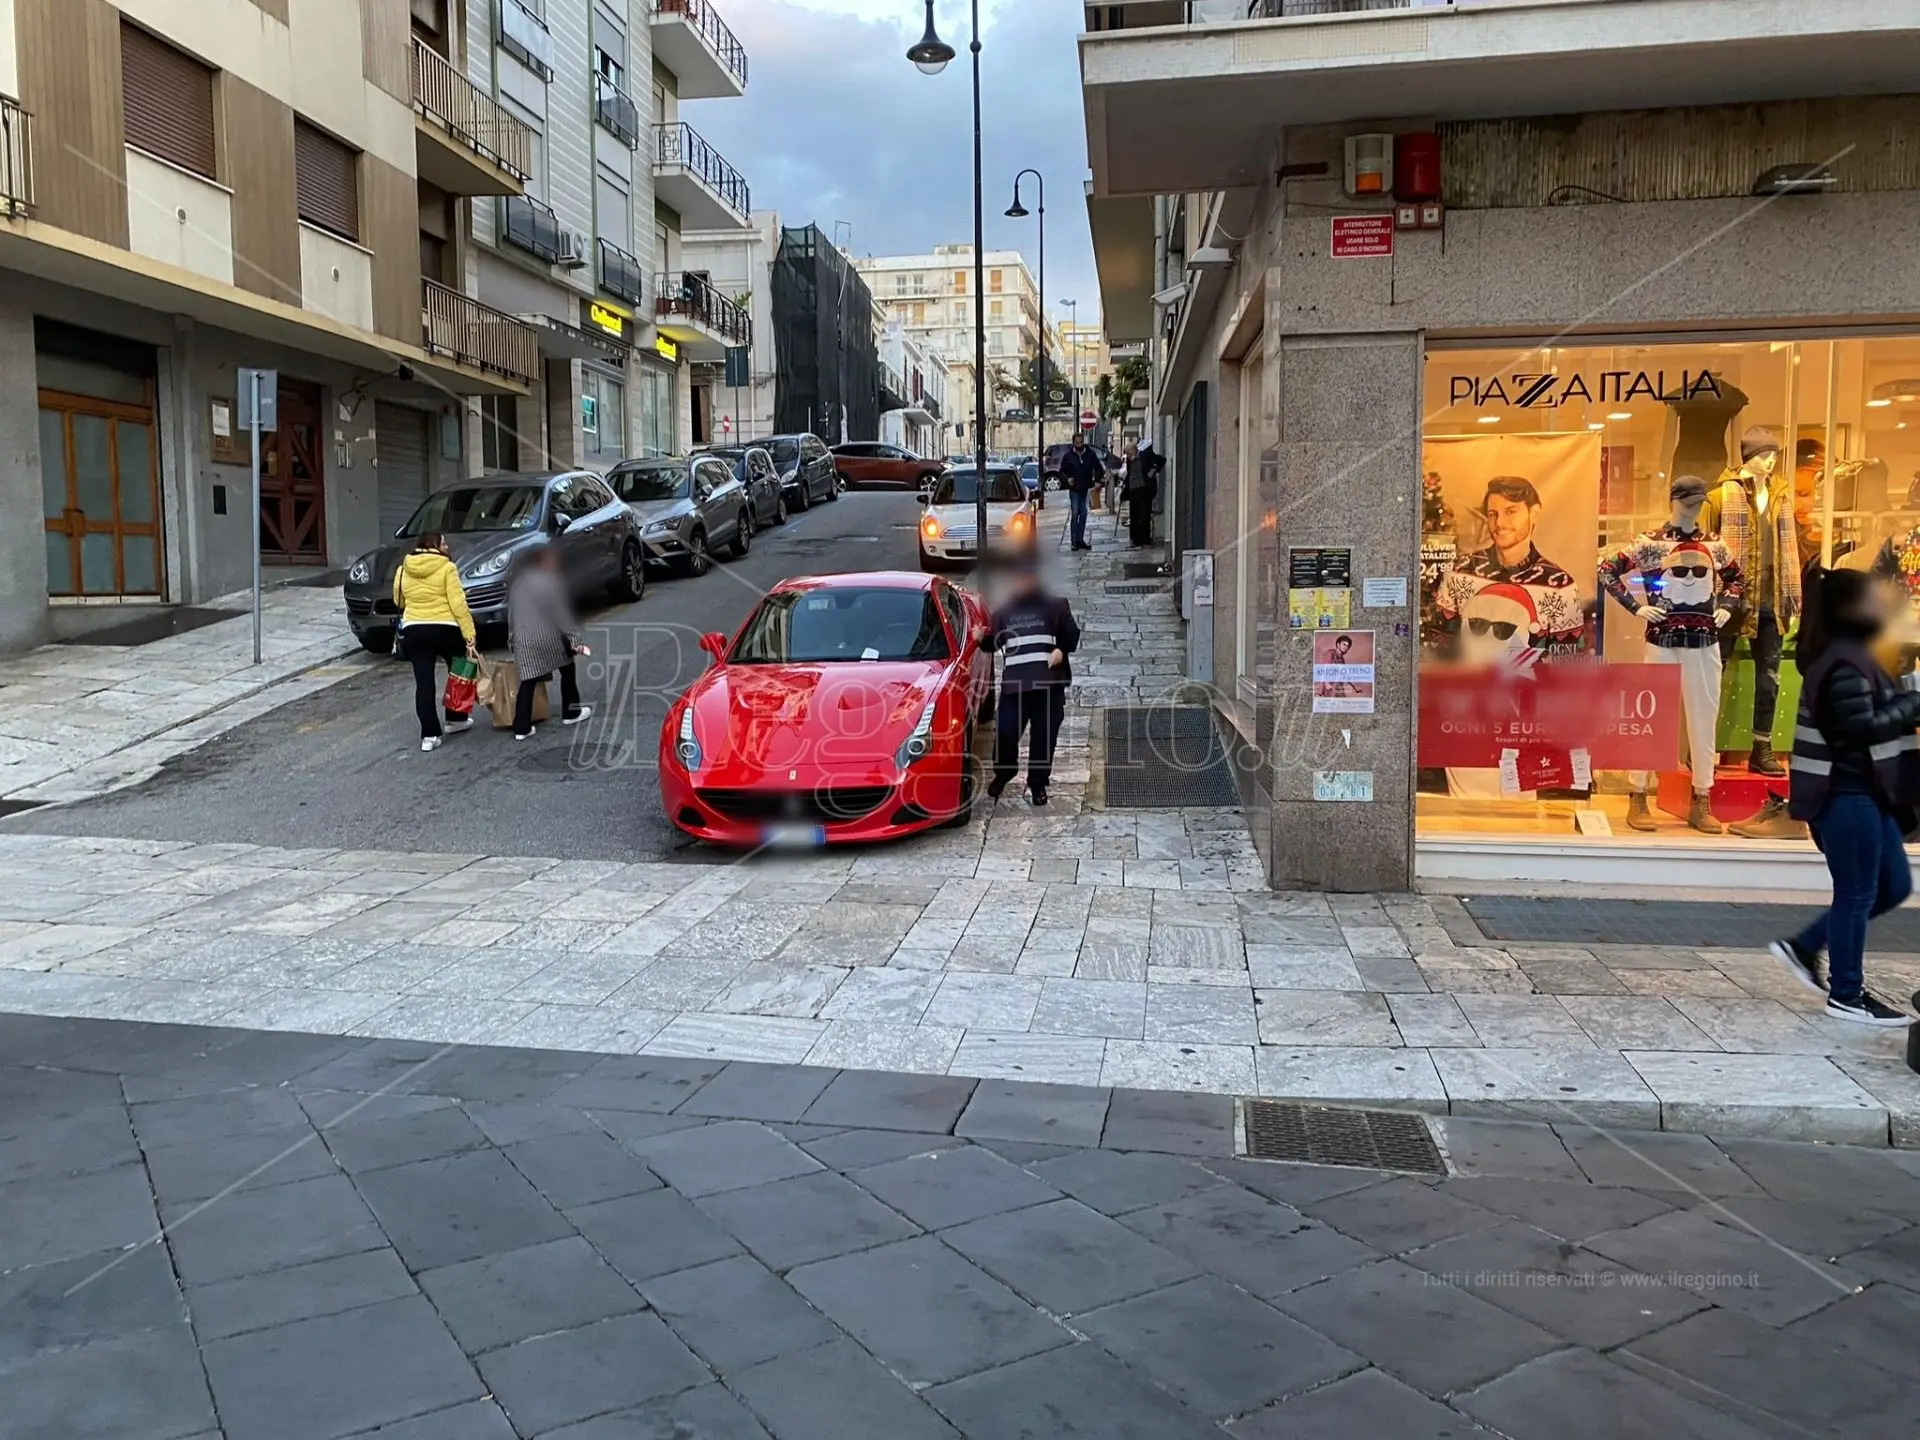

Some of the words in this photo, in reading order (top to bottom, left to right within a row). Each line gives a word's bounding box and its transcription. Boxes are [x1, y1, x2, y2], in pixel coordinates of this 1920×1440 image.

[1600, 369, 1722, 403] ITALIA
[1548, 643, 1577, 655] OGNI
[1440, 722, 1486, 734] OGNI
[1493, 722, 1502, 734] 5
